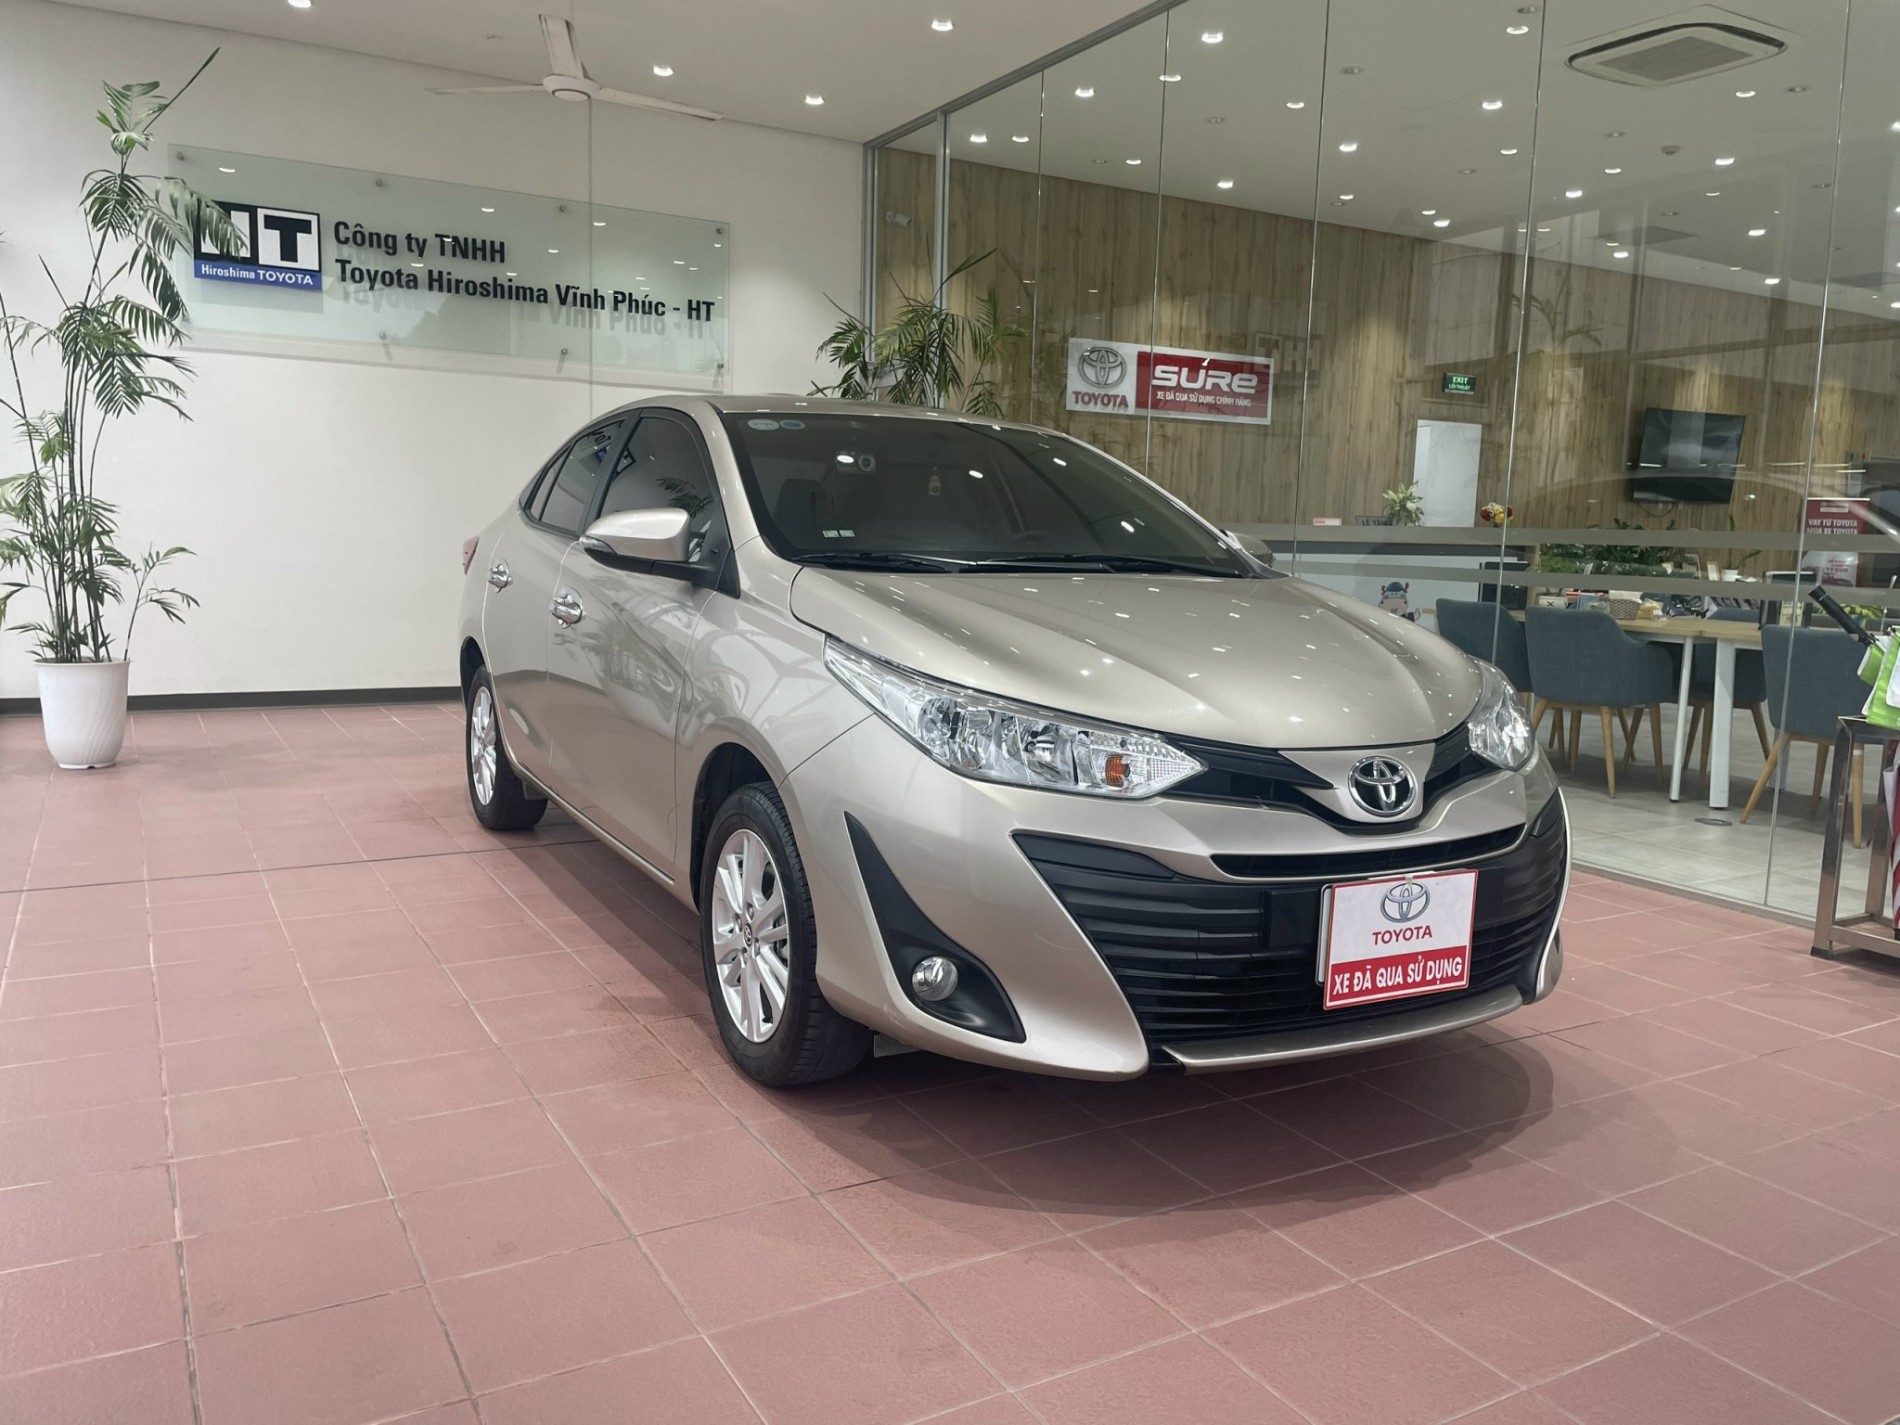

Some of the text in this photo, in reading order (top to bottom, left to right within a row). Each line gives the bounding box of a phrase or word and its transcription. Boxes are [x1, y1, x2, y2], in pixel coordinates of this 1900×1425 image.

[334, 221, 505, 263] Công ty TNHH
[201, 264, 313, 285] Hiroshima TOYOTA
[335, 258, 419, 291] Toyota
[427, 269, 548, 304] Hiroshima
[555, 284, 605, 310] Vĩnh
[613, 290, 666, 317] Phúc
[687, 299, 715, 322] HT
[1452, 376, 1469, 384] EXIT
[1072, 390, 1129, 409] TOYOTA
[1156, 391, 1165, 400] XE
[1175, 392, 1188, 402] QUA
[1372, 925, 1433, 946] TOYOTA
[1333, 955, 1463, 995] XE ĐÃ QUA SỬ DỤNG
